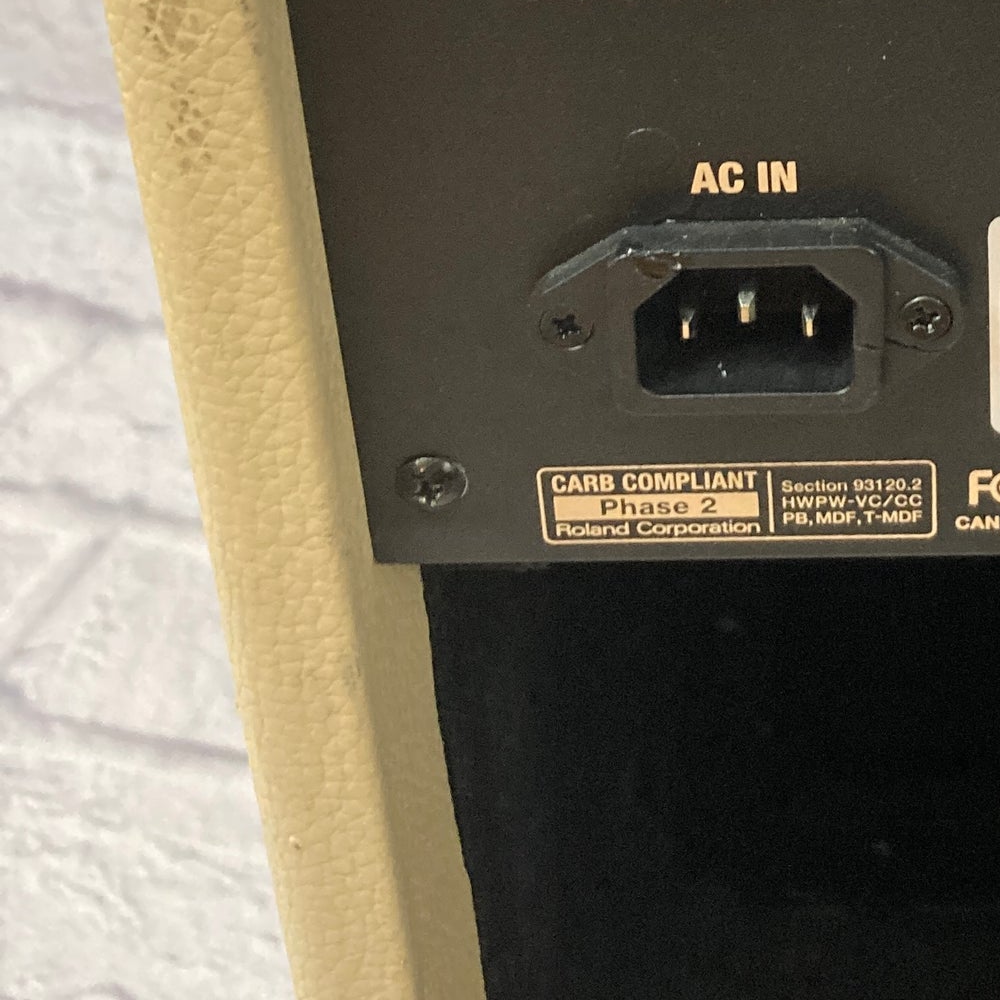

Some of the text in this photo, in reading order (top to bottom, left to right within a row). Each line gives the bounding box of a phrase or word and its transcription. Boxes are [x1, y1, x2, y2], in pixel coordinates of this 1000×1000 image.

[690, 160, 799, 194] AC IN
[551, 470, 758, 493] CARB COMPLIANT
[781, 478, 923, 493] Section 93120.2
[600, 496, 719, 516] Phase 2
[781, 494, 923, 508] HWPW-VC/CC
[555, 519, 761, 537] Roland Corporation
[955, 515, 999, 530] CAN
